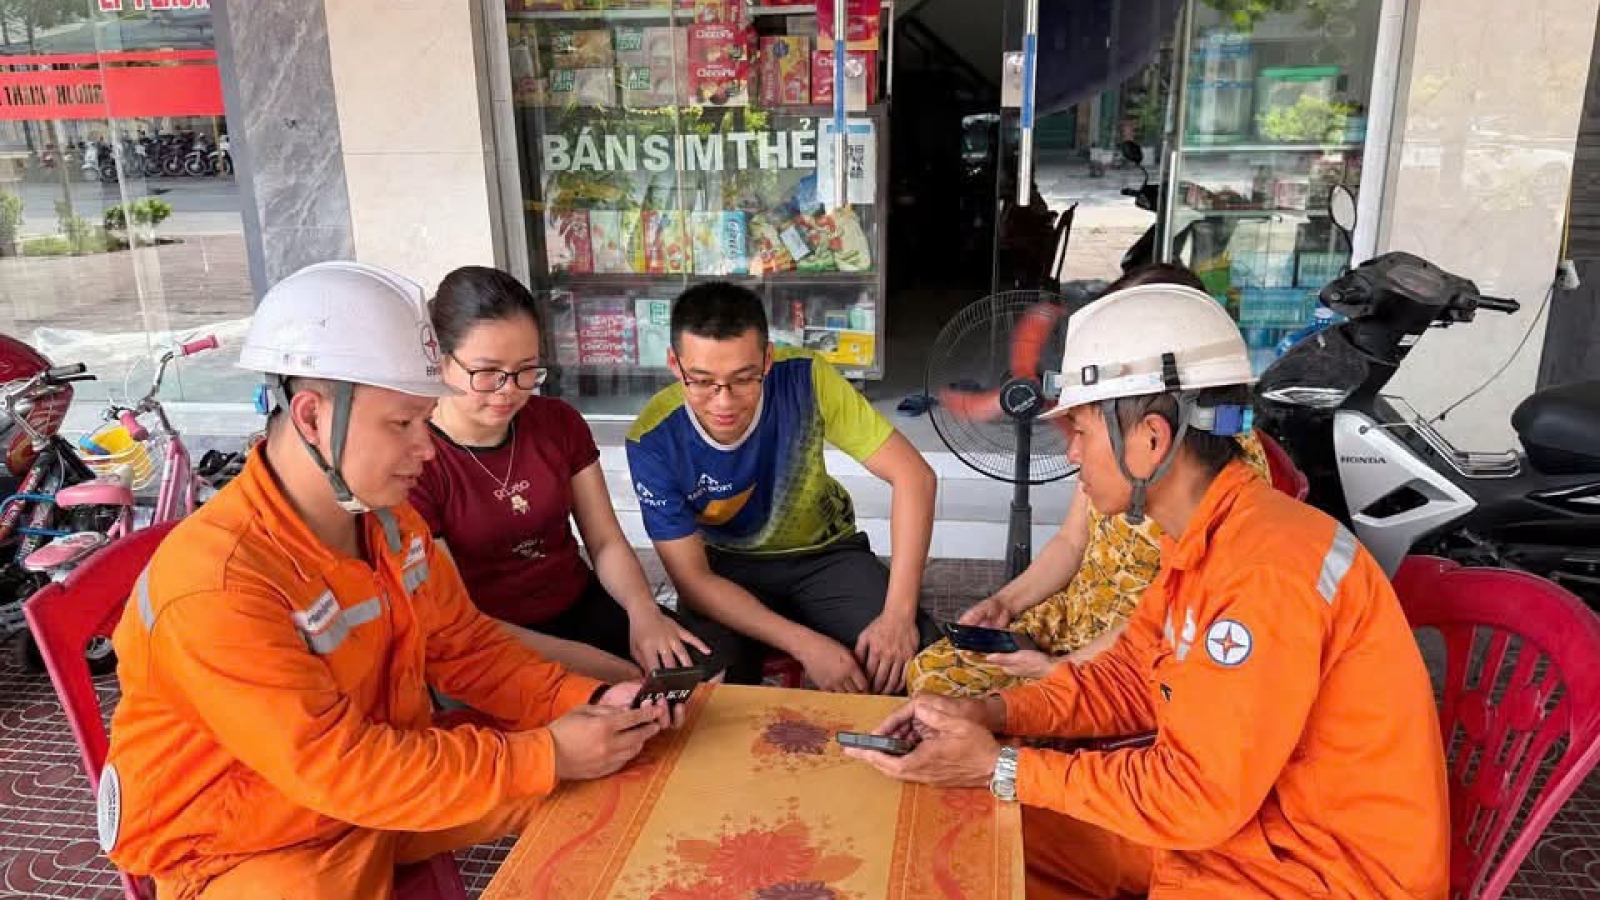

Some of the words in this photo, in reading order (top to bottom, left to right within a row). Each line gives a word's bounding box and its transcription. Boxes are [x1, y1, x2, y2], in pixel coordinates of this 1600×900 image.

[542, 126, 638, 171] BÁN
[642, 133, 724, 171] SIM
[727, 117, 817, 169] THẺ
[1340, 456, 1387, 464] HONDA
